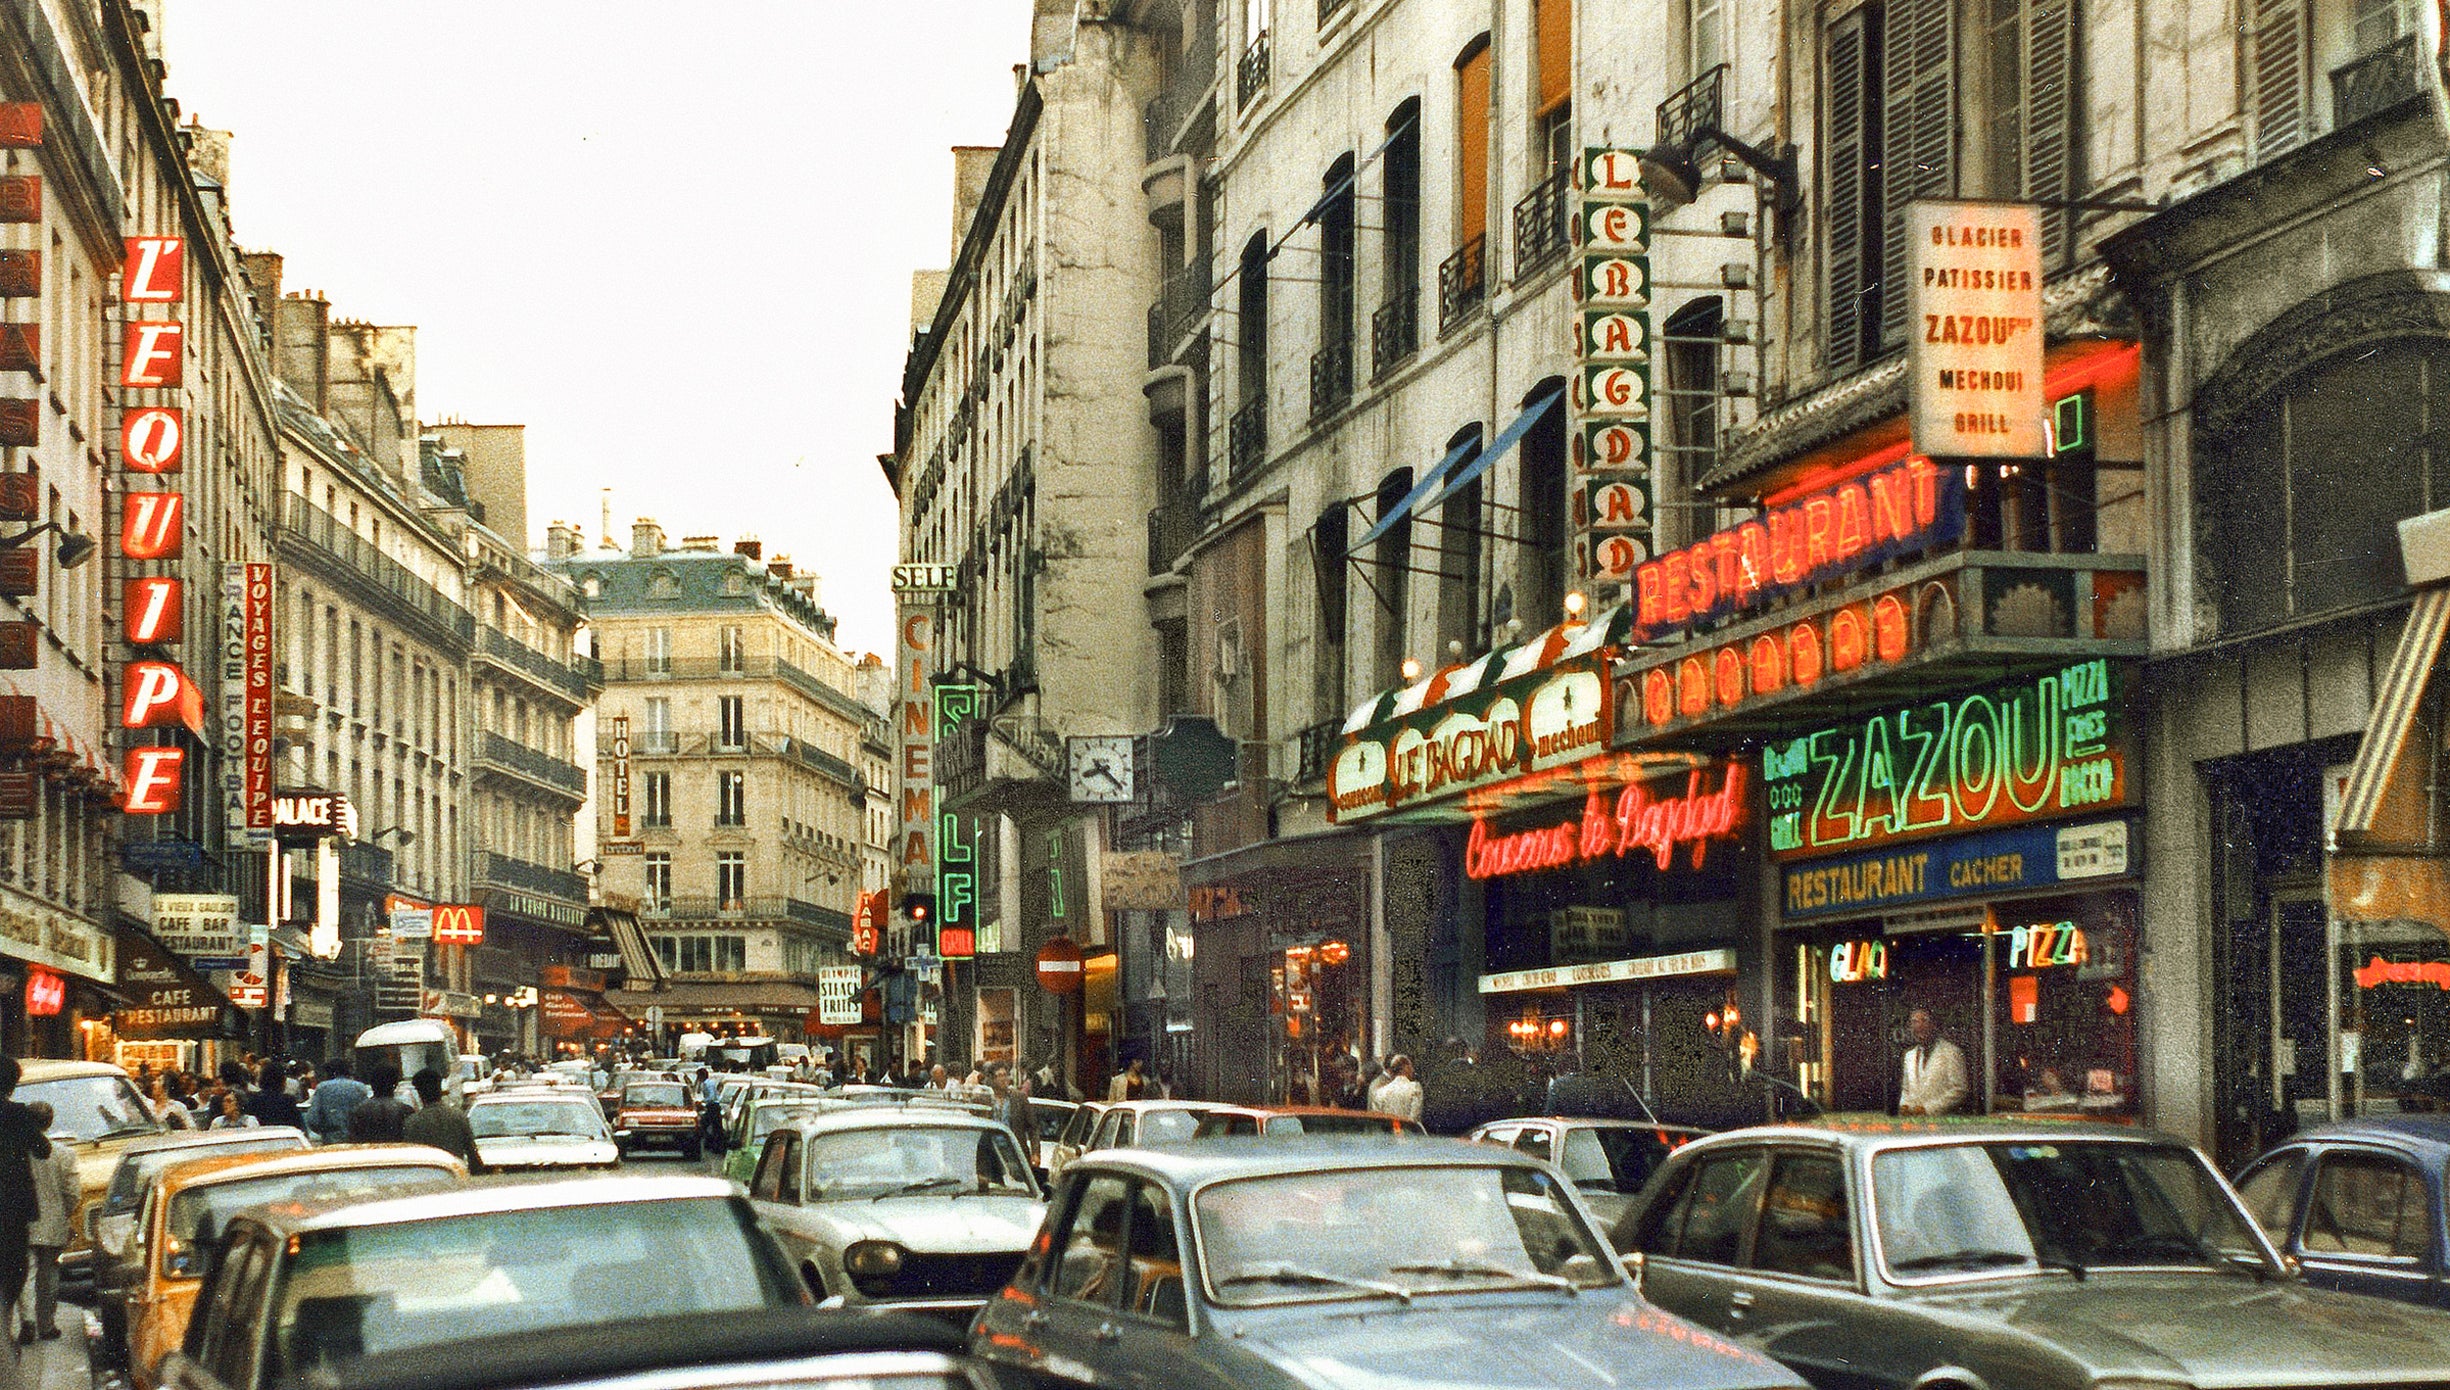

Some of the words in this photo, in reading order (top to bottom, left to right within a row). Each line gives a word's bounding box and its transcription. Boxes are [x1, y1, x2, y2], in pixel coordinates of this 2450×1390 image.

[1931, 226, 2023, 248] GLACIER
[1923, 267, 2033, 291] PATISSIER
[1925, 314, 2007, 345] ZAZOU
[1939, 369, 2023, 393] MECHOUI
[1954, 412, 2011, 434] GRILL
[124, 239, 182, 810] L'EQUIPE
[1637, 459, 1940, 627] RESTAURANT
[892, 566, 956, 589] SELF
[226, 565, 243, 681] FRANCE
[251, 565, 269, 687] VOYAGES
[904, 614, 929, 867] CINEMA
[1426, 719, 1520, 793] BAGDAD
[1538, 711, 1600, 759] mechoui
[614, 720, 629, 815] HOTEL
[1809, 677, 2059, 847] ZAZOU
[943, 694, 972, 923] SLF
[1616, 763, 1745, 871] Bagdad
[1787, 852, 1930, 911] RESTAURANT
[1950, 853, 2024, 888] CACHER
[154, 935, 235, 951] ESTAURANT
[159, 916, 191, 931] CAFE
[202, 917, 230, 931] BAR
[859, 893, 873, 951] TABAC
[941, 928, 975, 956] GRILL
[2009, 920, 2090, 968] PIZZA
[126, 1005, 219, 1025] RESTAURANT
[151, 988, 192, 1006] CAFE
